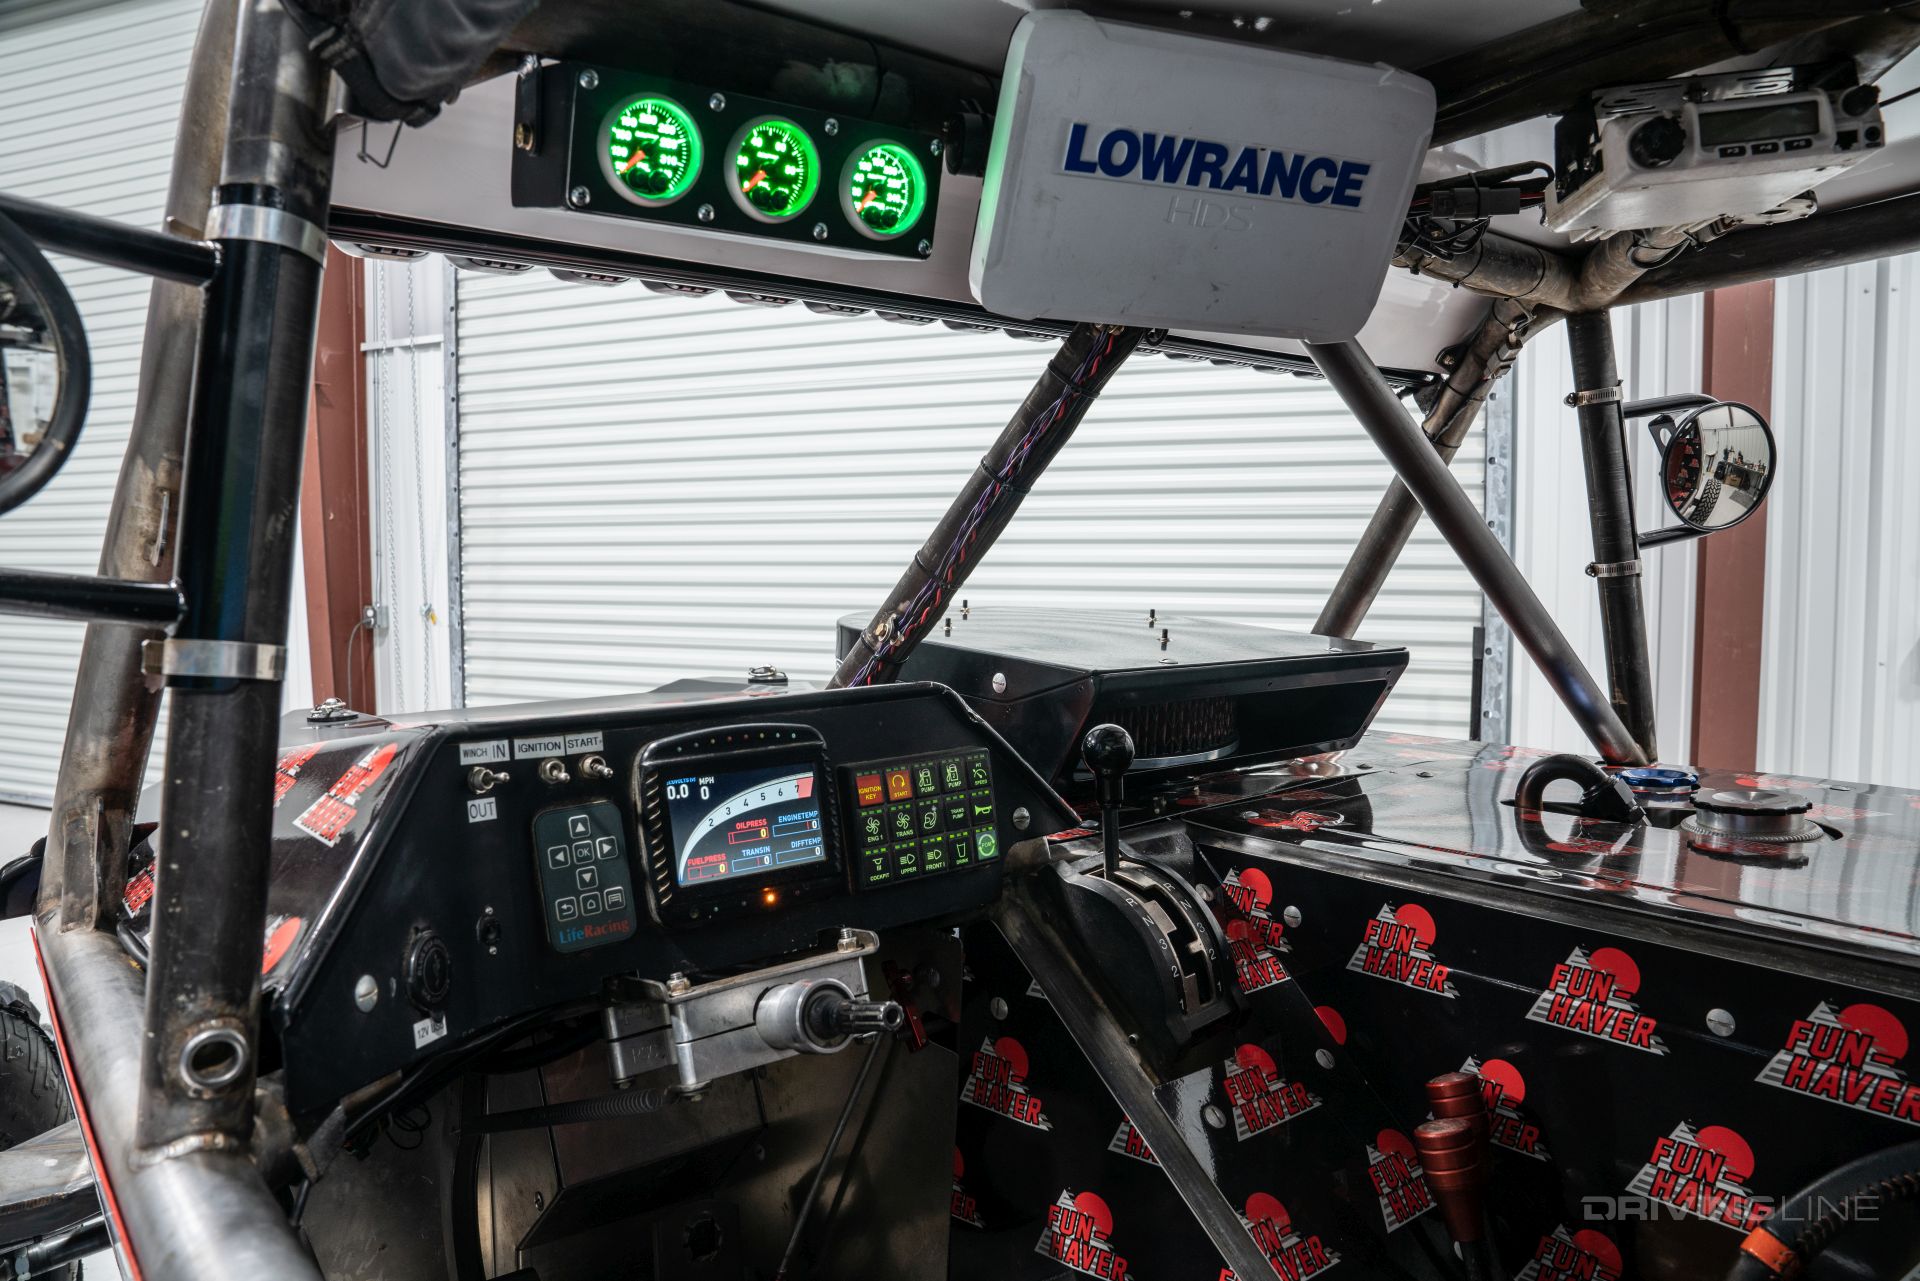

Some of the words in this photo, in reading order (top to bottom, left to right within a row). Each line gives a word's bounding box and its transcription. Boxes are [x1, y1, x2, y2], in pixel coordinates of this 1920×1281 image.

[1063, 123, 1371, 208] LOWRANCE
[1166, 195, 1255, 232] HDS
[518, 741, 561, 752] IGNITION
[567, 737, 599, 748] START
[463, 747, 488, 758] WINCH
[492, 744, 506, 759] IN
[699, 777, 714, 785] MPH
[667, 784, 689, 800] 0.0
[701, 786, 709, 800] 0
[858, 786, 881, 795] IGNITION
[470, 804, 494, 819] OUT
[708, 818, 714, 827] 2
[725, 807, 731, 815] 3
[743, 798, 749, 807] 4
[760, 792, 766, 801] 5
[778, 811, 818, 823] ENGINETEMP
[736, 819, 767, 830] OILPRESS
[812, 820, 817, 829] 0
[760, 830, 766, 838] 0
[791, 837, 822, 848] DIFFTEMP
[577, 847, 590, 859] OK
[742, 846, 771, 857] TRANSIN
[815, 847, 821, 856] 0
[688, 854, 726, 866] FUELPRESS
[764, 856, 769, 865] 0
[926, 863, 943, 871] FRONT
[720, 864, 725, 873] 0
[900, 867, 917, 875] UPPER
[870, 873, 889, 881] COCKPIT
[1163, 883, 1175, 892] R
[1180, 899, 1193, 911] N
[1197, 922, 1205, 933] 3
[1209, 948, 1217, 960] 2
[559, 918, 629, 944] LifeRacing
[1125, 897, 1138, 908] R
[1142, 915, 1155, 927] N
[1159, 938, 1168, 950] 3
[1171, 965, 1179, 978] 2
[1363, 919, 1429, 954] FUN-
[1362, 947, 1450, 993] HAVER
[1549, 963, 1634, 1002] FUN-
[1547, 994, 1658, 1050] HAVER
[1786, 1019, 1897, 1070] FUN-
[972, 1051, 1025, 1086] FUN-
[1223, 1065, 1278, 1106] FUN-
[972, 1077, 1042, 1127] HAVER
[1240, 1080, 1314, 1134] HAVER
[1649, 1136, 1745, 1184] FUN-
[1387, 1176, 1430, 1224] HAV
[1048, 1204, 1109, 1243] FUN-
[1050, 1232, 1129, 1281] HAVER
